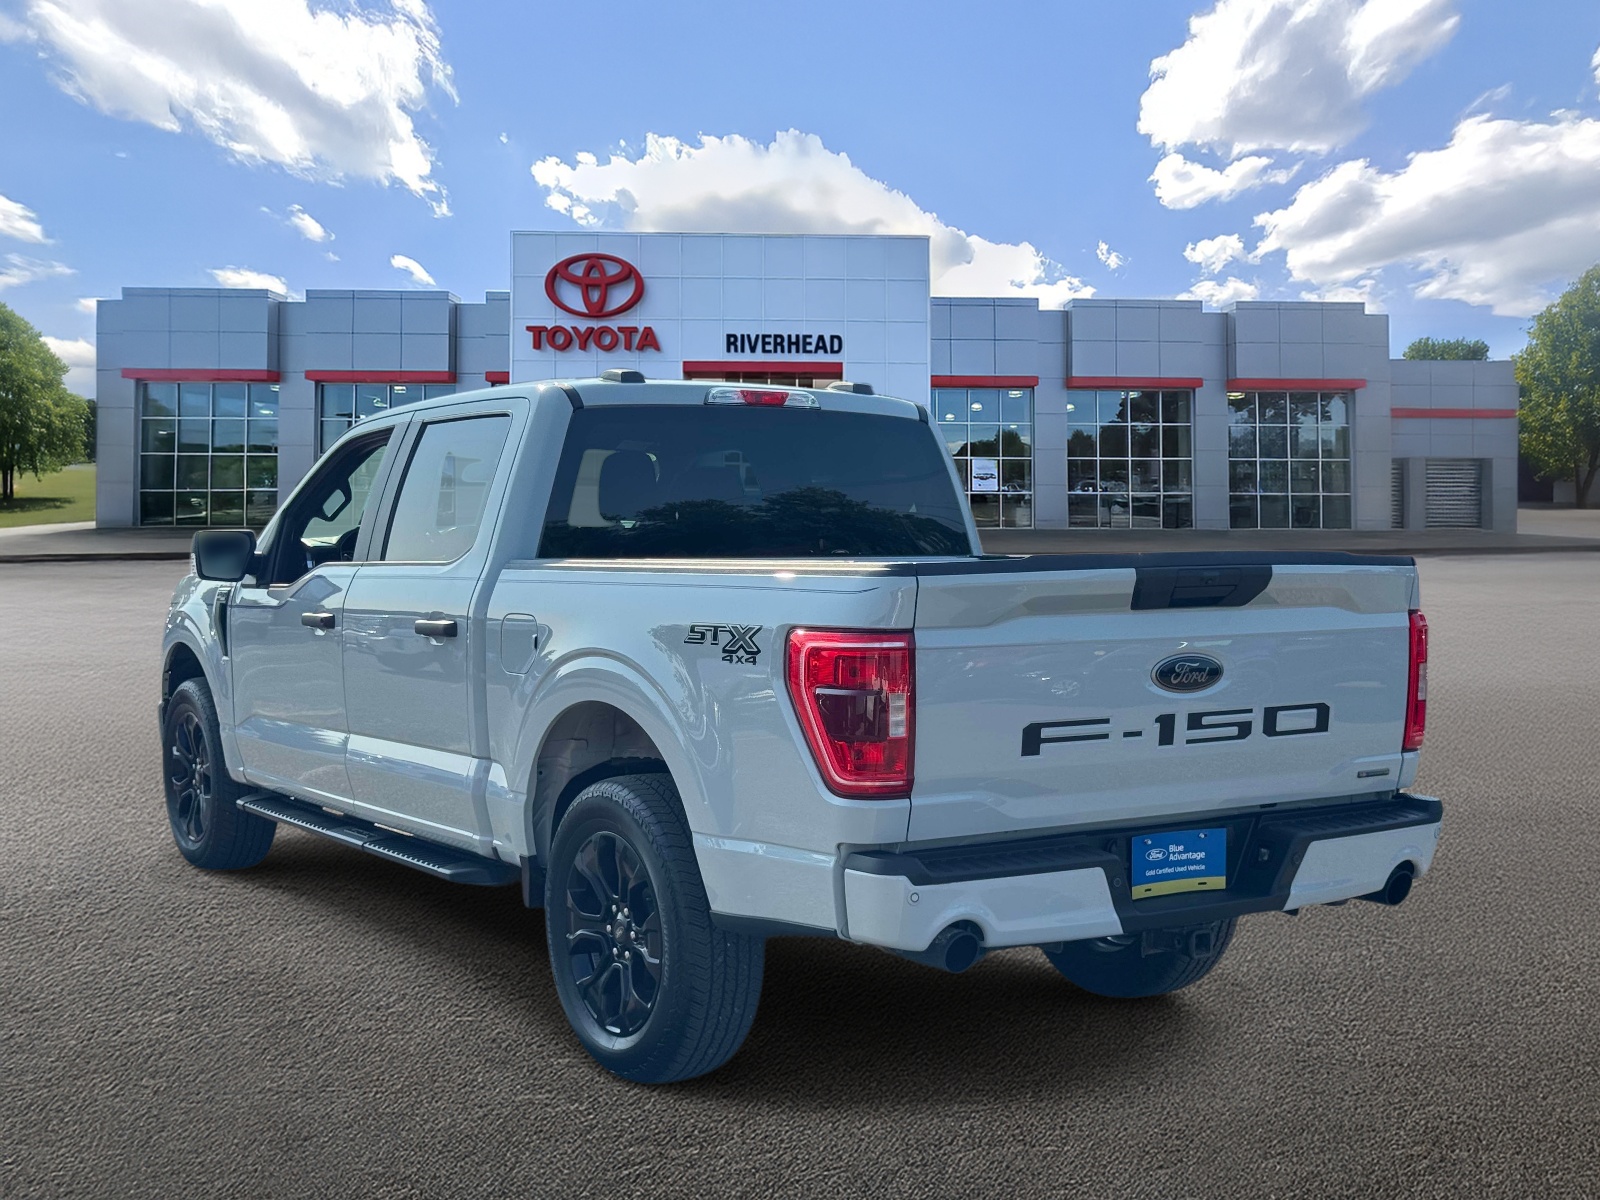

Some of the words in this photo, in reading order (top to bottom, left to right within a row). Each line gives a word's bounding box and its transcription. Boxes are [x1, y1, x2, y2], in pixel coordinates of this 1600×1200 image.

[526, 325, 661, 353] TOYOTA
[725, 333, 844, 355] RIVERHEAD
[684, 622, 763, 655] STX
[1170, 661, 1210, 684] Ford
[1020, 703, 1331, 757] F-150
[1168, 844, 1184, 853] Blue
[1168, 851, 1206, 862] Advantage
[1187, 863, 1206, 871] Vehicle
